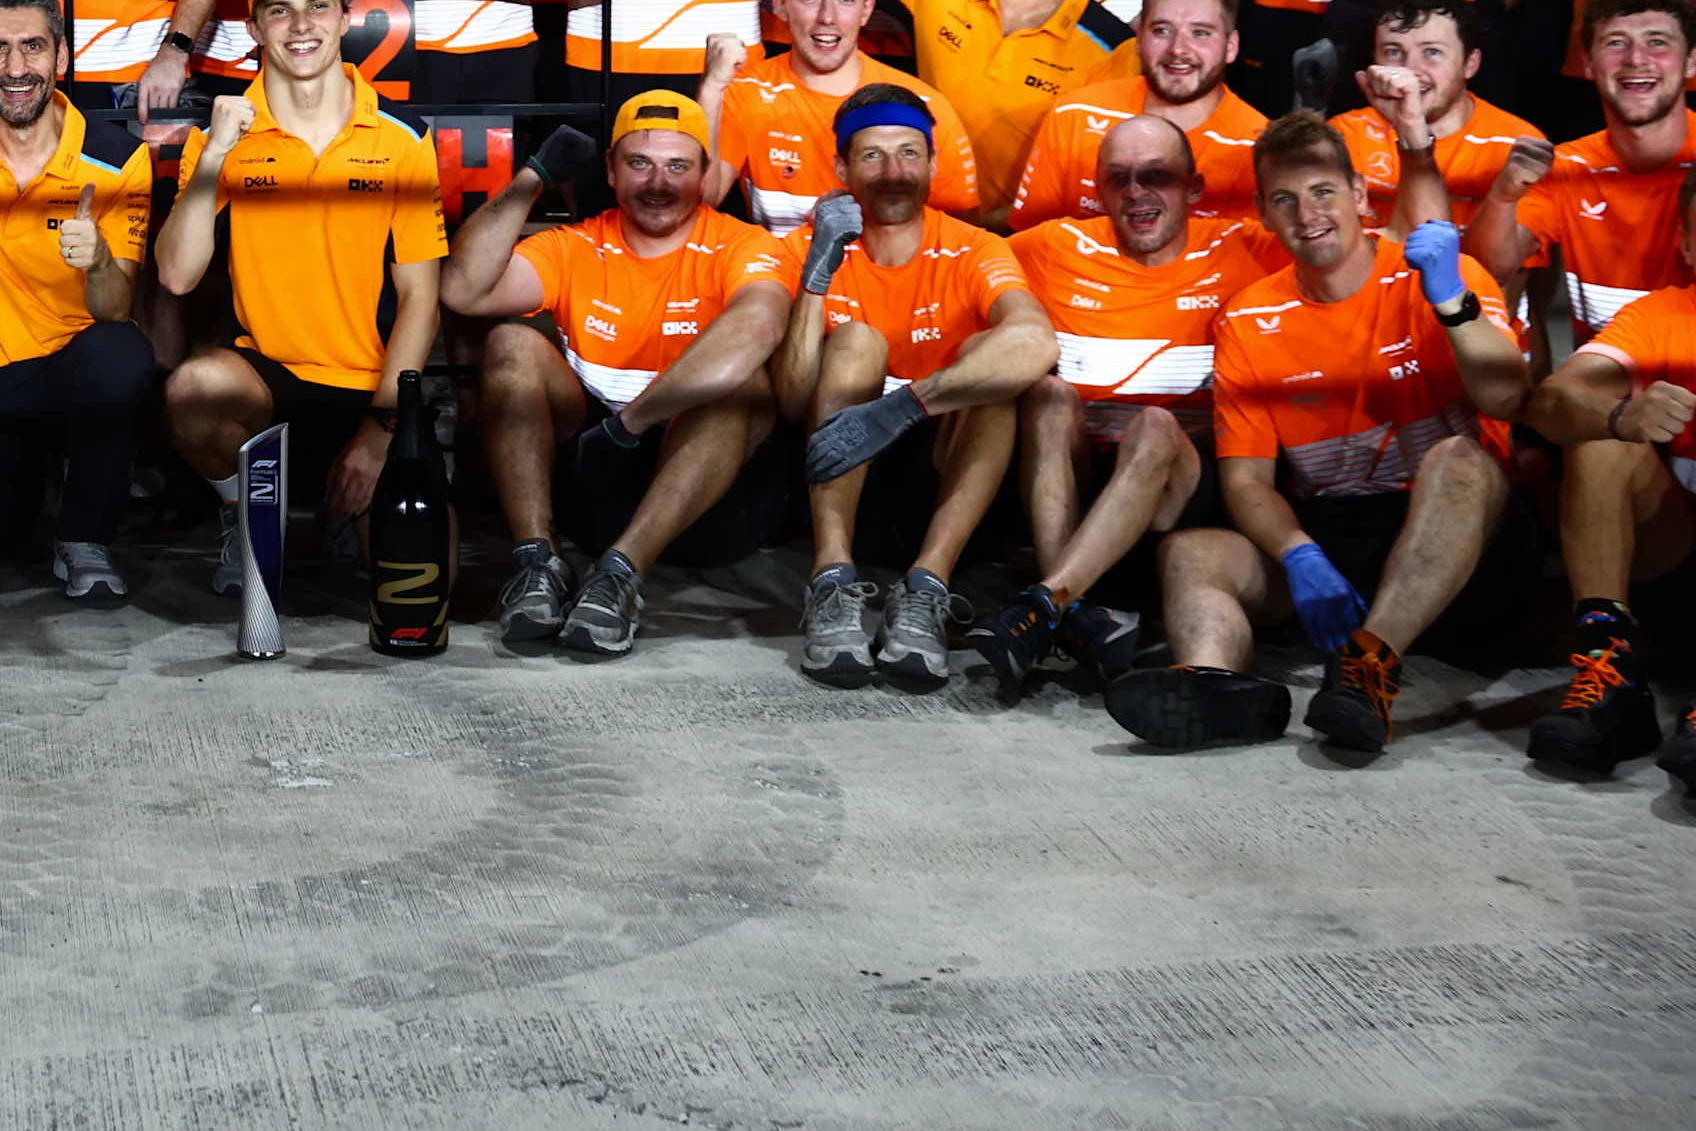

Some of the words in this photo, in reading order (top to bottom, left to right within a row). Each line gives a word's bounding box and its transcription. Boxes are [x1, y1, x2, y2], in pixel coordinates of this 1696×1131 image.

[770, 148, 802, 163] DELL
[245, 175, 278, 188] DELL
[349, 179, 383, 192] OKX
[1177, 295, 1220, 310] OKX
[585, 315, 617, 336] DELL
[662, 321, 698, 335] OKX
[250, 483, 274, 499] 2
[377, 561, 440, 604] 2
